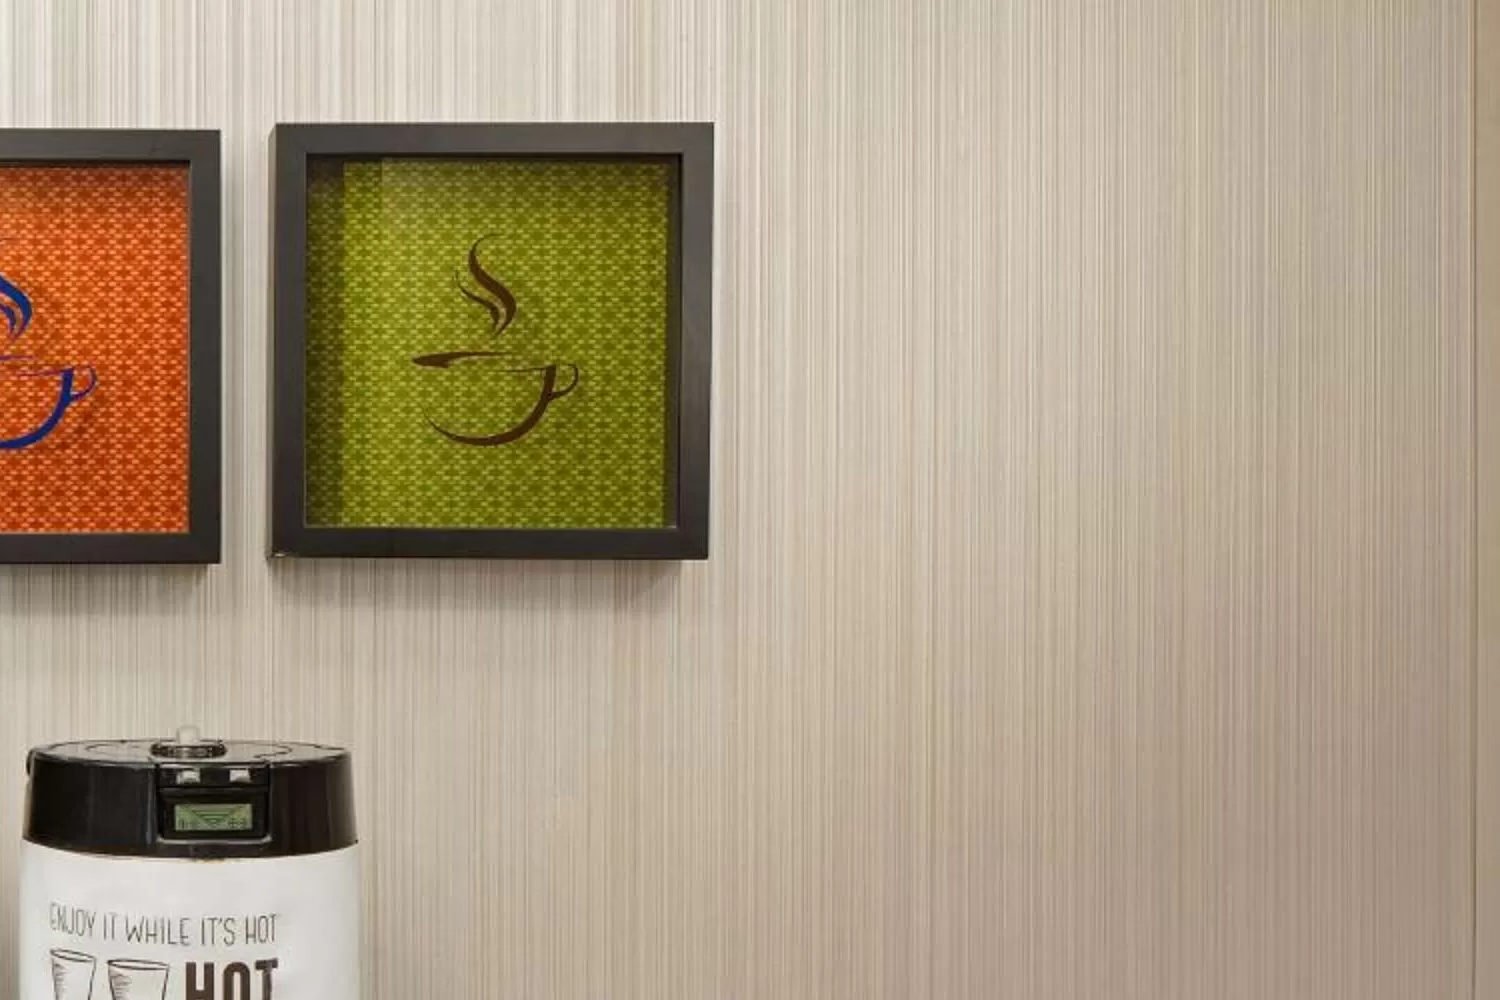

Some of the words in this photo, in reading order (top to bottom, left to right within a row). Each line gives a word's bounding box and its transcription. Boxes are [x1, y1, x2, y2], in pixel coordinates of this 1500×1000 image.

[50, 901, 97, 938] ENJOY
[103, 911, 119, 941] IT
[124, 913, 192, 947] WHILE
[201, 914, 237, 947] IT'S
[245, 911, 278, 945] HOT
